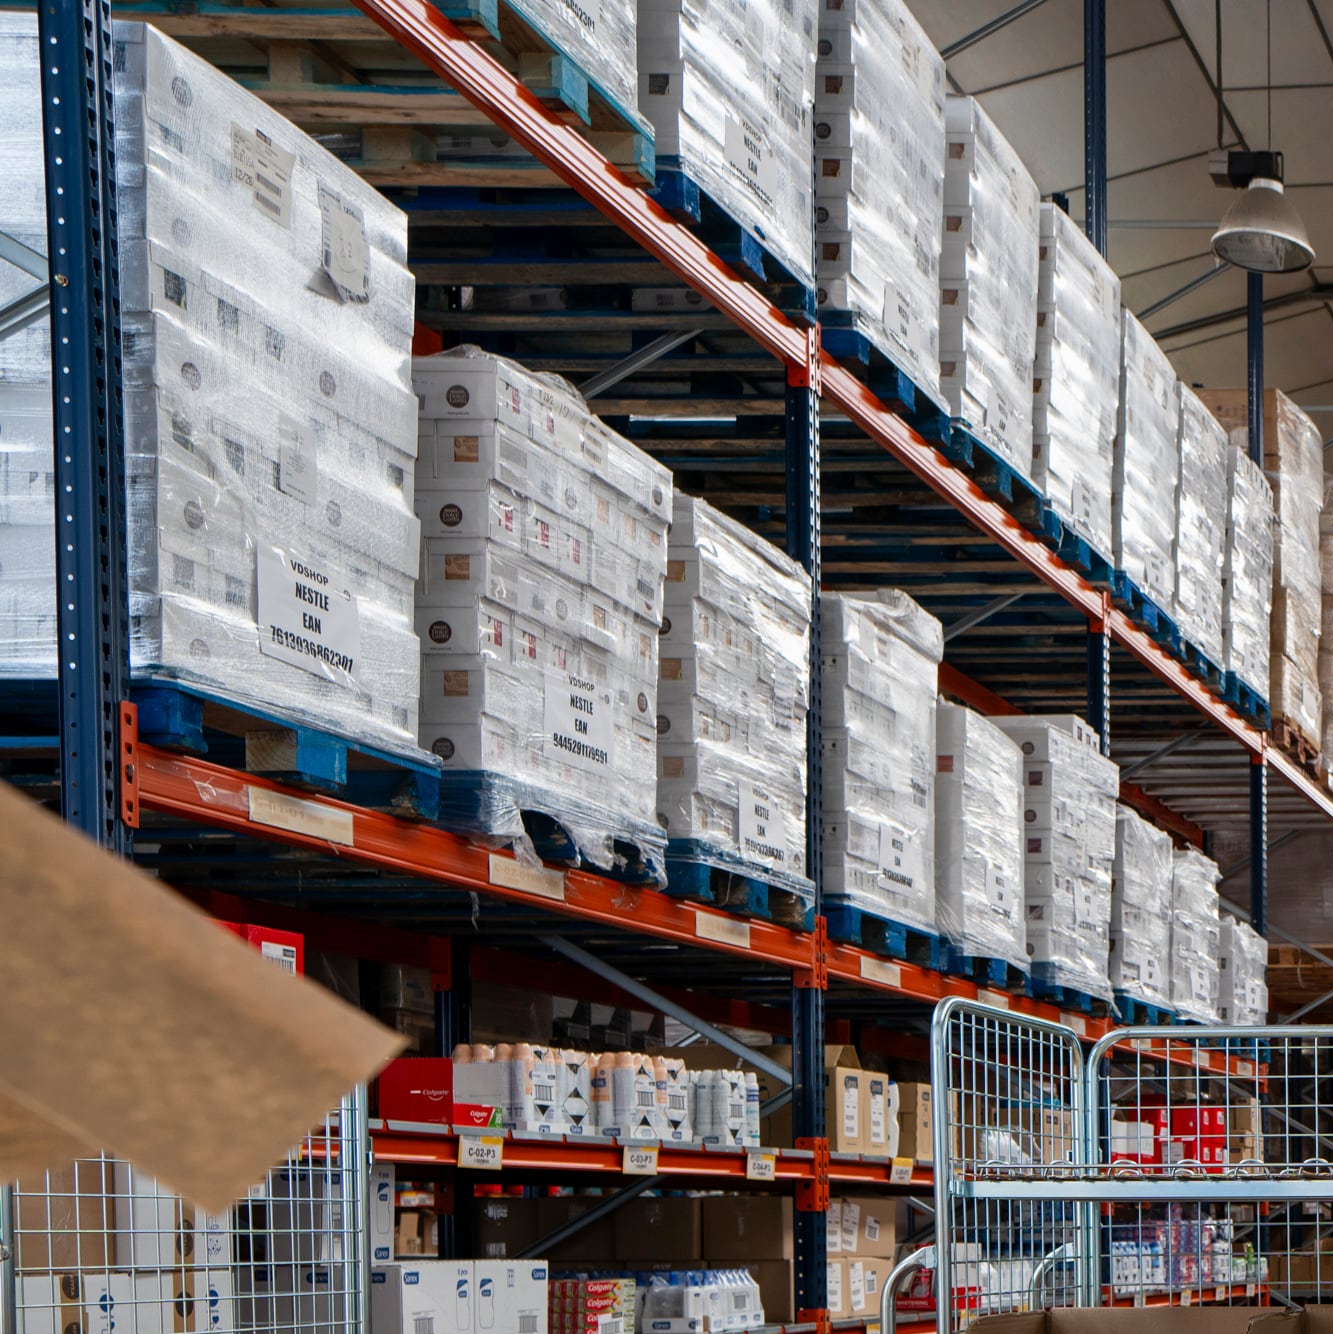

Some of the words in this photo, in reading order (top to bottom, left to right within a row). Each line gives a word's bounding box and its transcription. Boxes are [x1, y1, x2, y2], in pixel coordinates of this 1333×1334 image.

[290, 559, 328, 586] VDSHOP
[295, 582, 329, 612] NESTLE
[302, 612, 321, 635] EAN
[569, 675, 595, 692] VDSHOP
[570, 693, 594, 715] NESTLE
[574, 718, 588, 735] EAN
[422, 1088, 449, 1097] Colgate
[470, 1110, 488, 1118] Colgate
[468, 1148, 496, 1159] C-02-P3
[405, 1274, 417, 1283] Sanex
[588, 1283, 615, 1293] Colgate
[587, 1298, 615, 1308] Colgate
